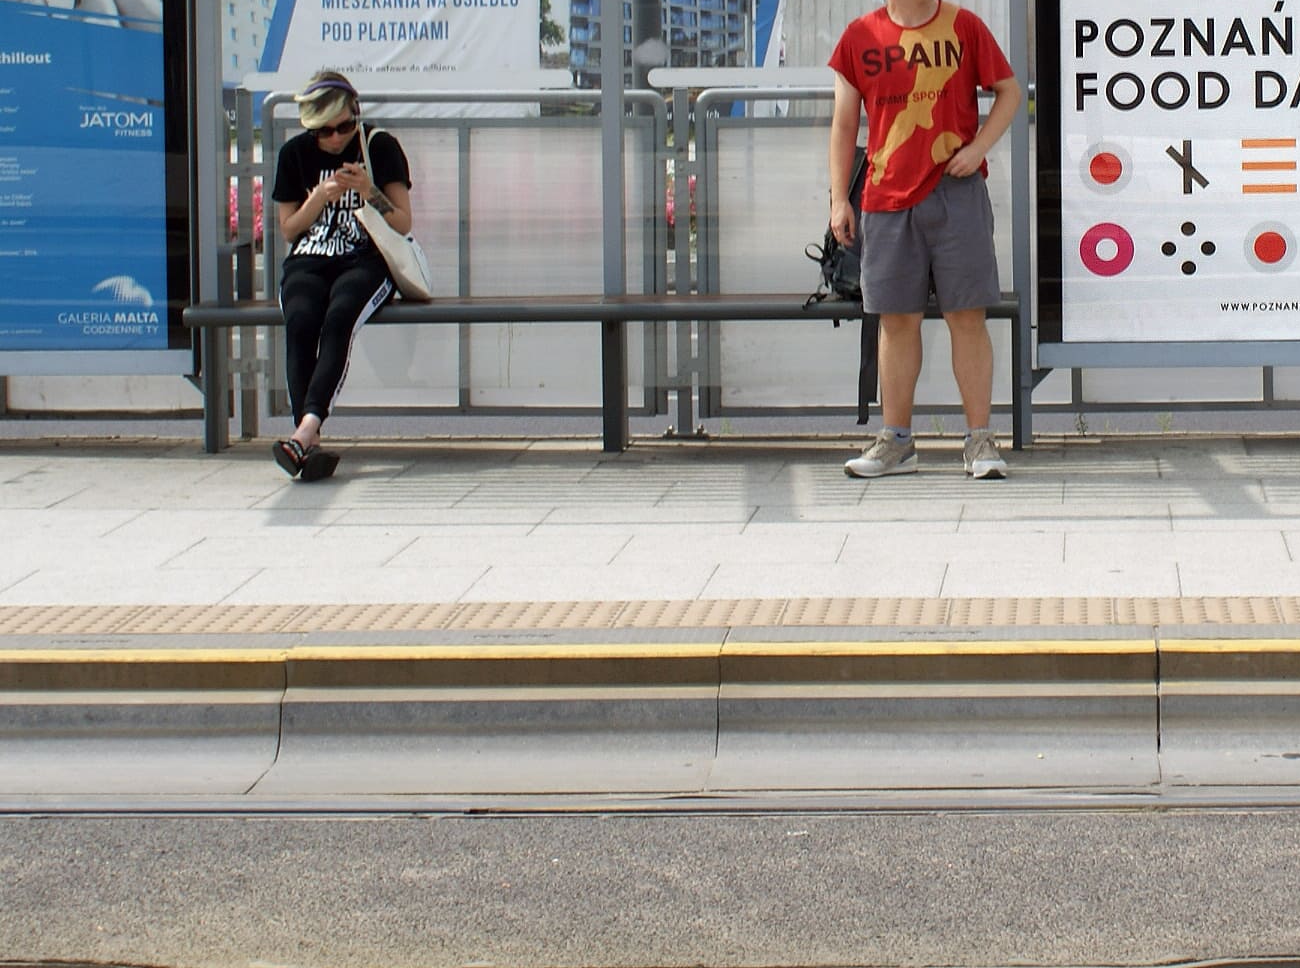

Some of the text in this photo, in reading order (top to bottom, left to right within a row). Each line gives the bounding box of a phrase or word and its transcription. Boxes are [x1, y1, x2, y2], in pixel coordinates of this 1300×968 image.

[322, 21, 449, 41] POD PLATANAMI
[1075, 0, 1293, 58] POZNAŃ
[862, 40, 963, 77] SPAIN
[1075, 70, 1230, 111] FOOD
[80, 112, 153, 128] JATOMI
[115, 129, 153, 137] FITNESS
[58, 312, 158, 324] GALERIA MALTA
[146, 325, 159, 335] TY
